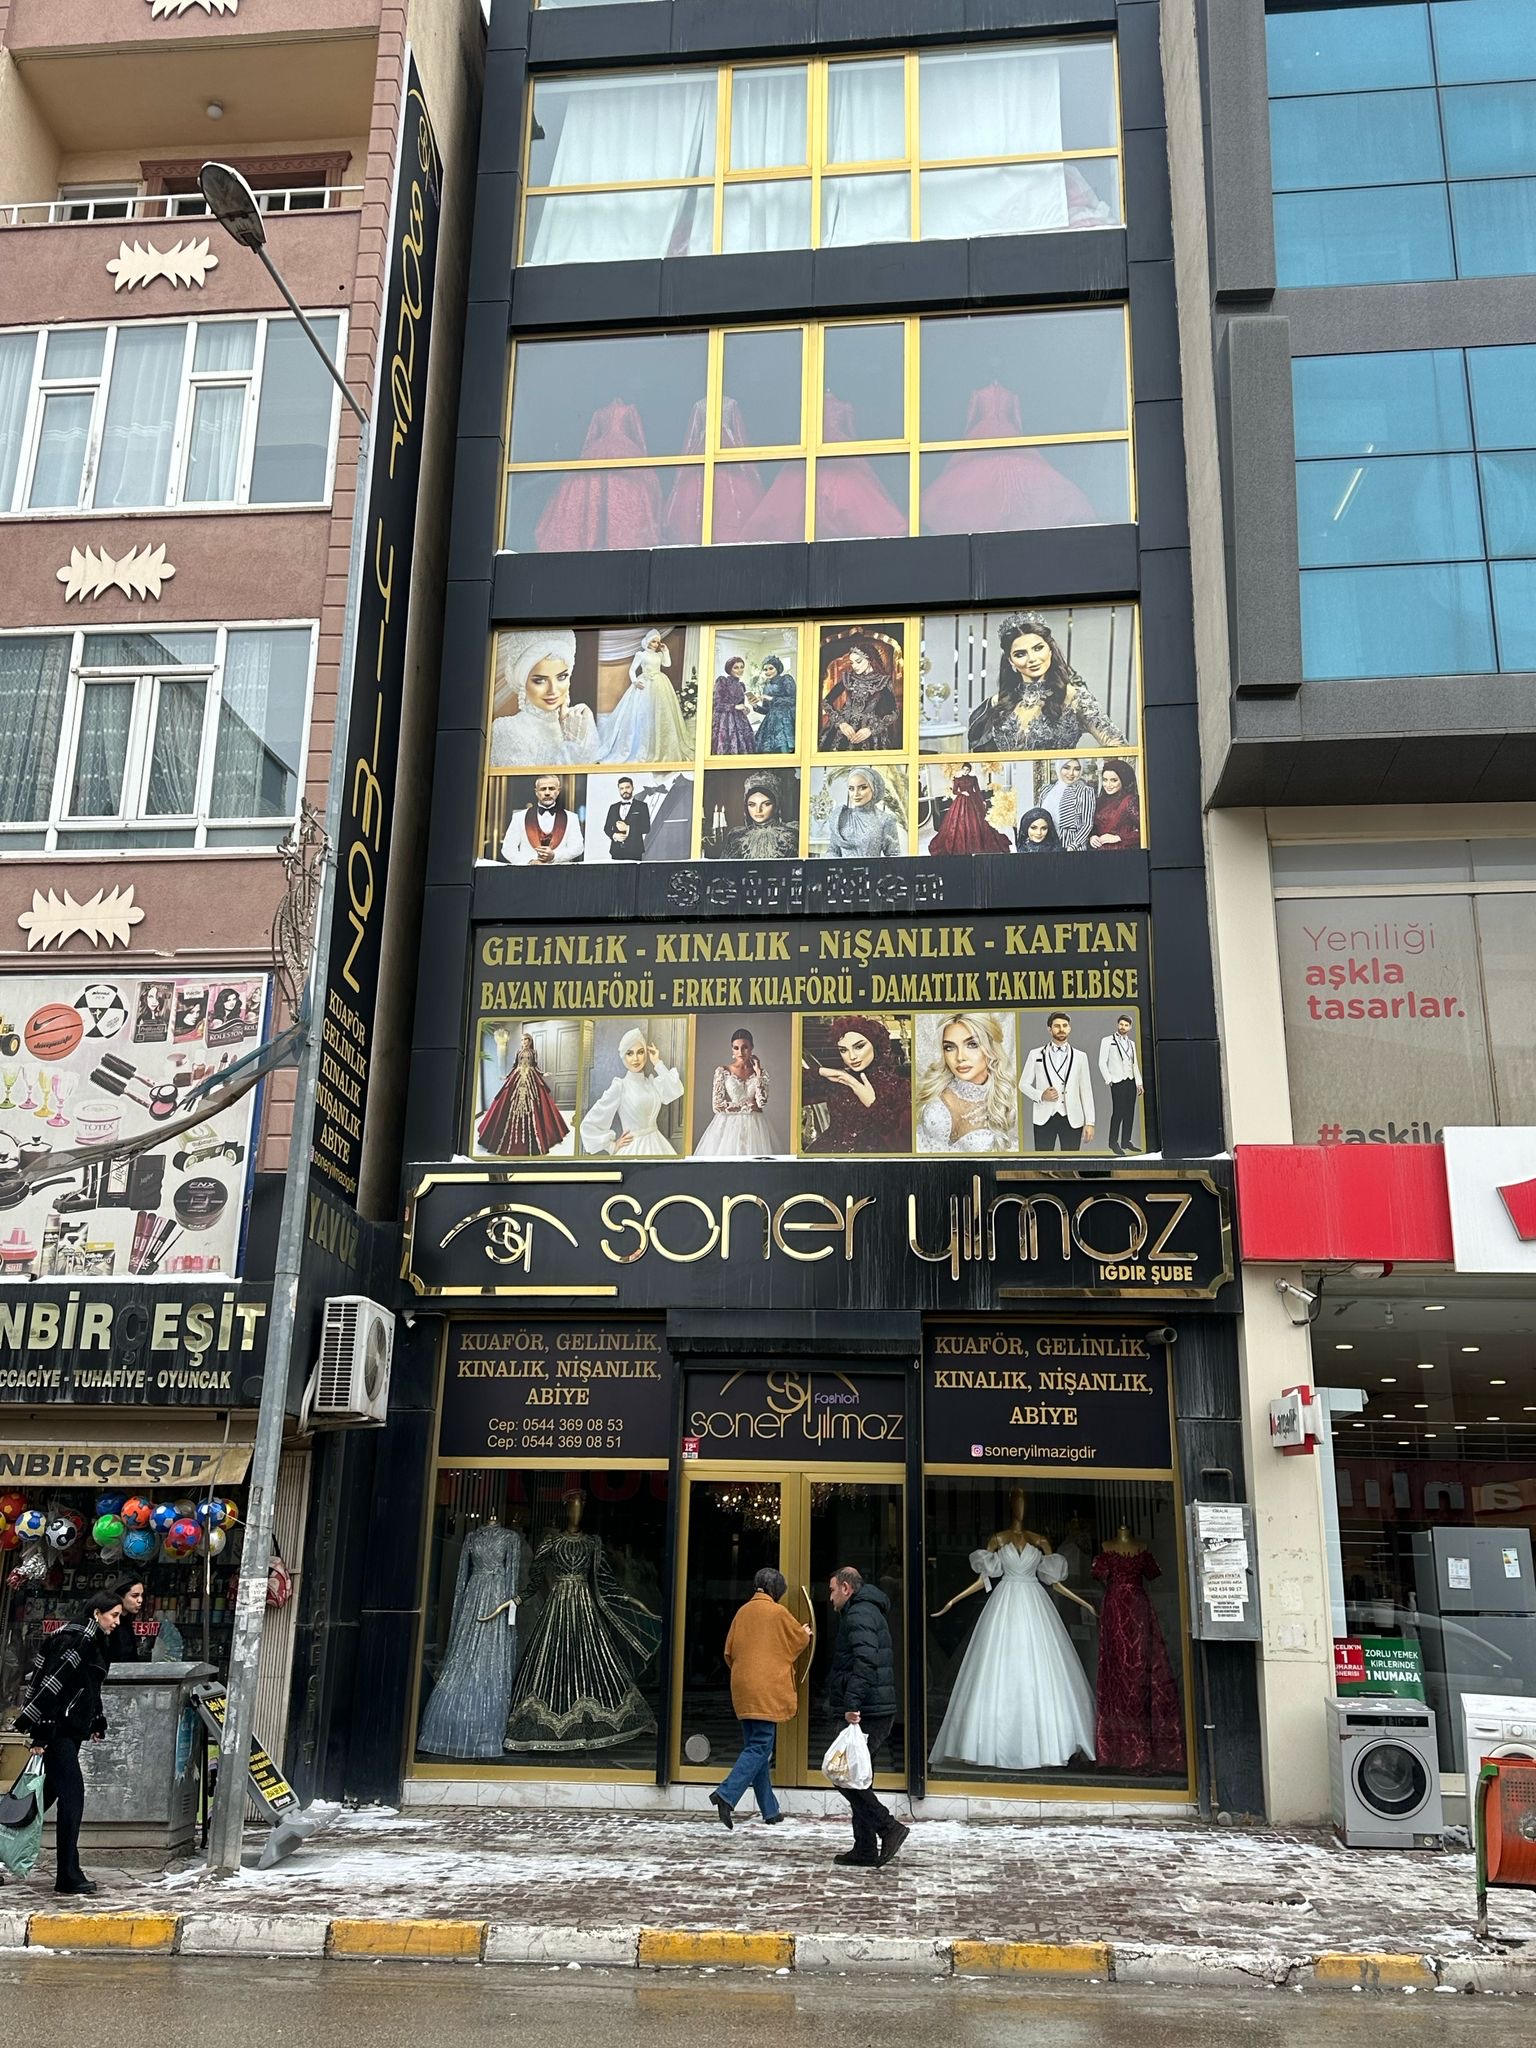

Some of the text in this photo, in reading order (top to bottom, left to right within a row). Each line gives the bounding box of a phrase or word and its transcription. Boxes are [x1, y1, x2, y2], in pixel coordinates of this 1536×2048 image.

[655, 931, 791, 963] KINALIK
[1004, 921, 1138, 955] KAFTAN
[1303, 921, 1435, 956] Yeniliği
[480, 979, 547, 1010] BAYAN
[552, 971, 654, 1009] KUAFÖRÜ
[672, 977, 743, 1007] ERKEK
[749, 966, 853, 1006] KUAFÖRÜ
[871, 971, 980, 1003] DAMATLIK
[986, 968, 1056, 1001] TAKIM
[1061, 959, 1138, 1000] ELBİSE
[1305, 957, 1405, 990] aşkla
[328, 987, 366, 1048] KUAFÖR
[1307, 991, 1466, 1022] tasarlar.
[321, 1018, 367, 1081] GELİNLİK
[321, 1051, 360, 1108] KINALIK
[315, 1080, 361, 1141] NİŞANLIK
[84, 1121, 114, 1131] TOTEX
[319, 1123, 350, 1165] ABİYE
[307, 1191, 359, 1270] YAVUZ
[600, 1193, 877, 1264] soner
[1150, 1264, 1193, 1286] ŞUBE
[460, 1328, 662, 1353] KUAFÖR, GELİNLİK,
[934, 1331, 1151, 1360] KUAFÖR, GELİNLİK,
[73, 1364, 146, 1388] TUHAFİYE
[157, 1369, 232, 1389] OYUNCAK
[456, 1354, 662, 1383] KINALIK, NİŞANLIK,
[933, 1366, 1153, 1395] KINALIK, NİŞANLIK,
[525, 1382, 590, 1406] ABİYE
[488, 1418, 623, 1433] Cep: 0544 369 08 53
[690, 1411, 793, 1439] soner
[1009, 1401, 1078, 1426] ABİYE
[487, 1435, 621, 1450] Cep: 0544 369 08 51
[984, 1444, 1097, 1461] soneryilmazigdir
[1340, 1650, 1349, 1664] 1
[1365, 1649, 1419, 1659] ZORLU YEMEK
[1365, 1670, 1371, 1680] 1
